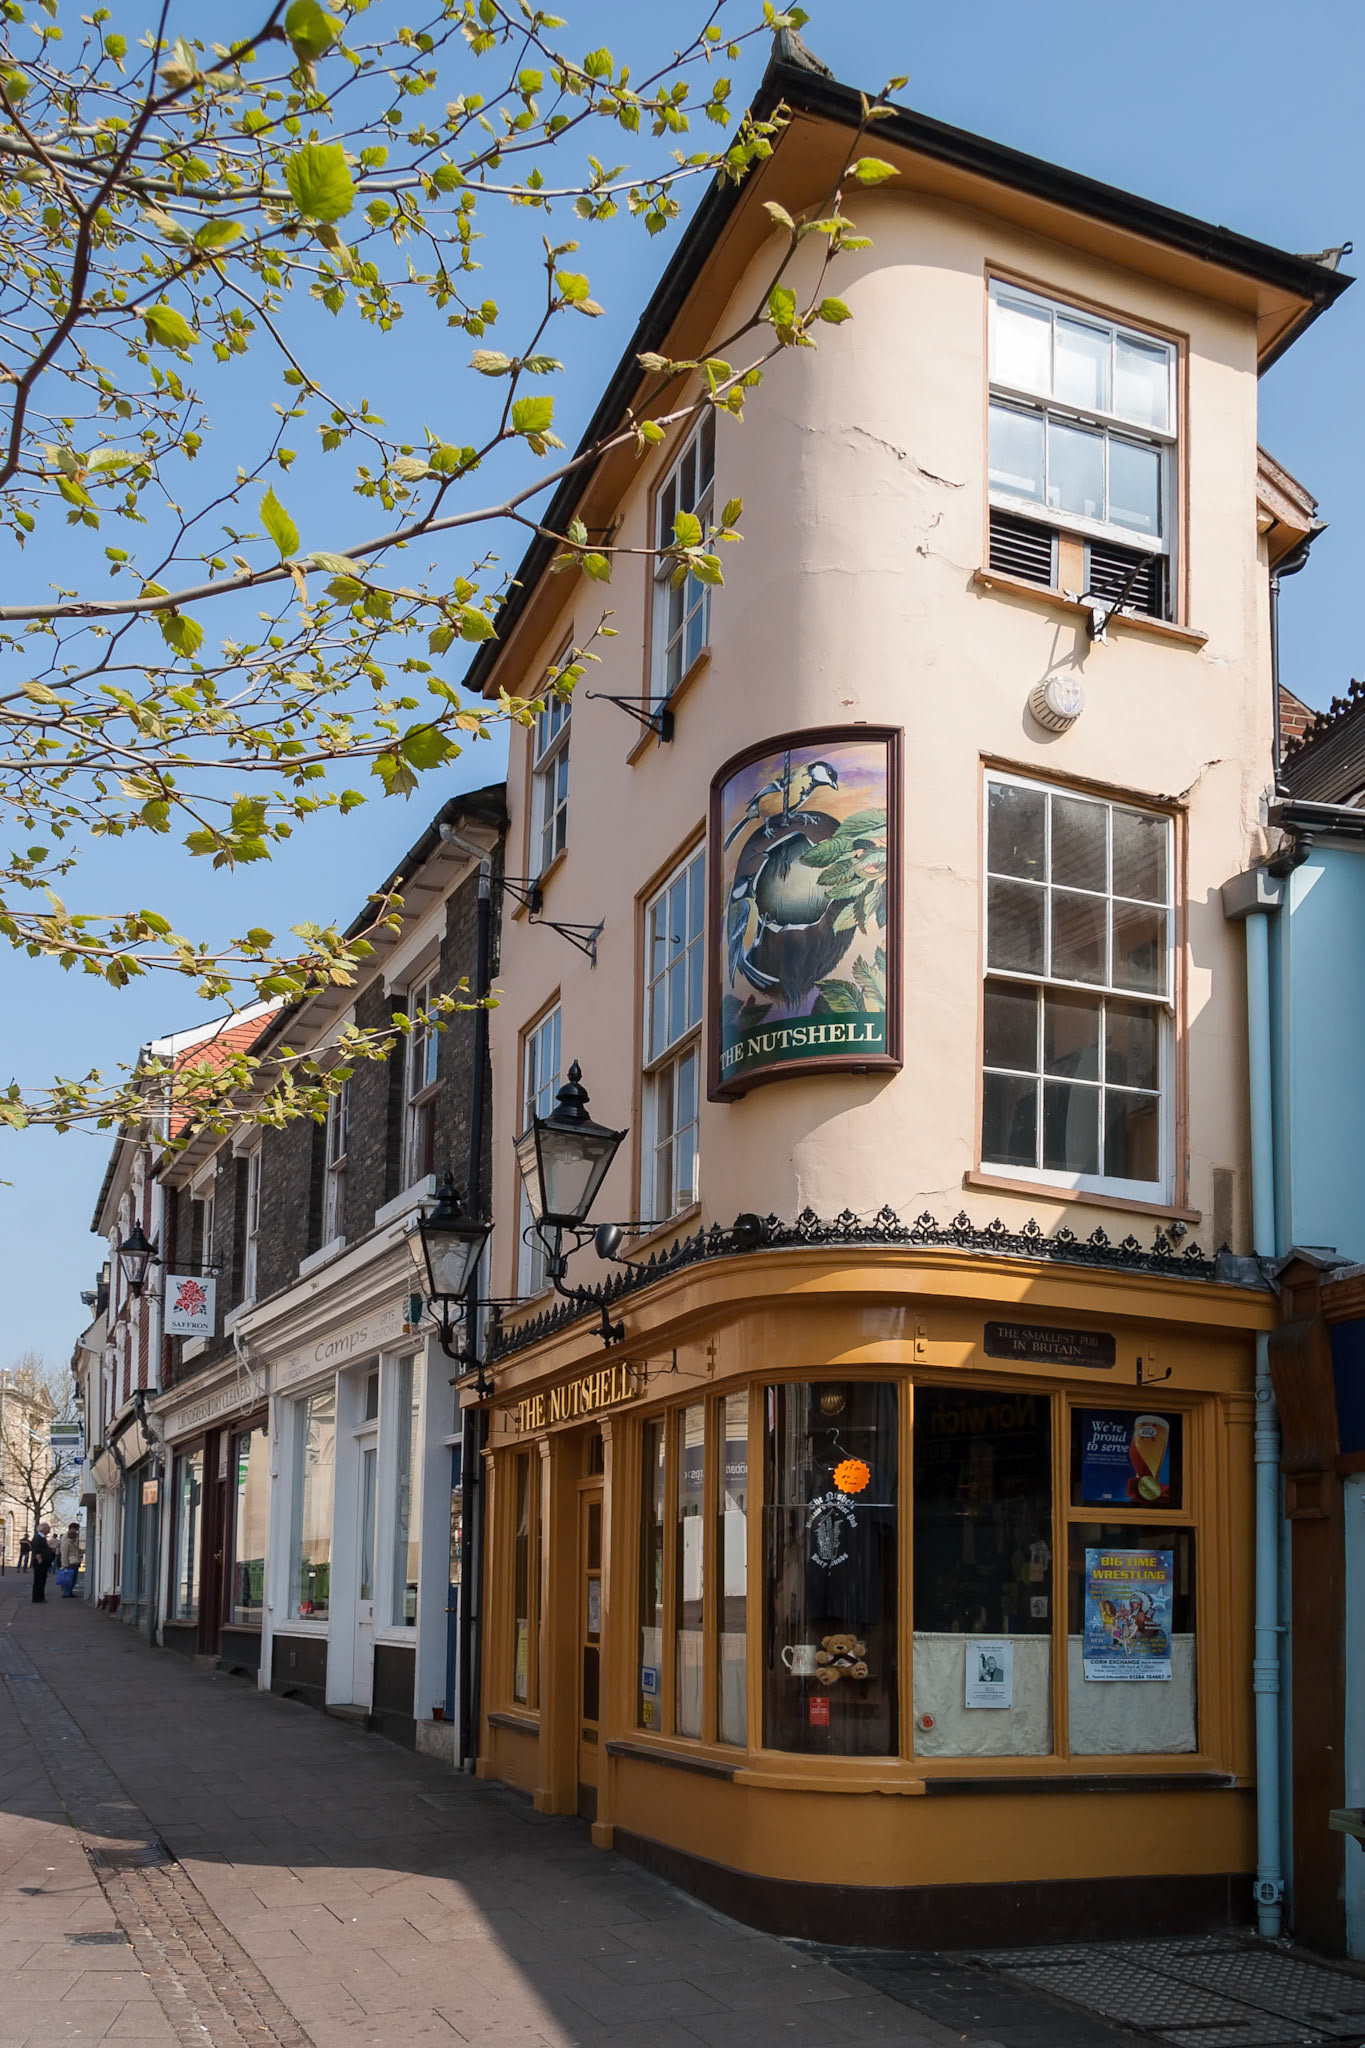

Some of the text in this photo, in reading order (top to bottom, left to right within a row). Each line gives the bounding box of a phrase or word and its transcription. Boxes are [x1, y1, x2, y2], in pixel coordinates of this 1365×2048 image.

[720, 1023, 882, 1070] THE NUTSHELL
[171, 1321, 209, 1329] SAFFRON
[314, 1326, 368, 1362] Camps
[998, 1328, 1099, 1347] THE SMALLEST PUB
[1013, 1340, 1081, 1355] IN BRITAIN
[518, 1362, 633, 1432] THE NUTSHELL
[1091, 1420, 1123, 1432] We're
[1092, 1431, 1127, 1444] proud
[1086, 1441, 1129, 1453] to serve
[1101, 1556, 1157, 1567] BIG TIME
[1092, 1570, 1166, 1580] WRESTLING
